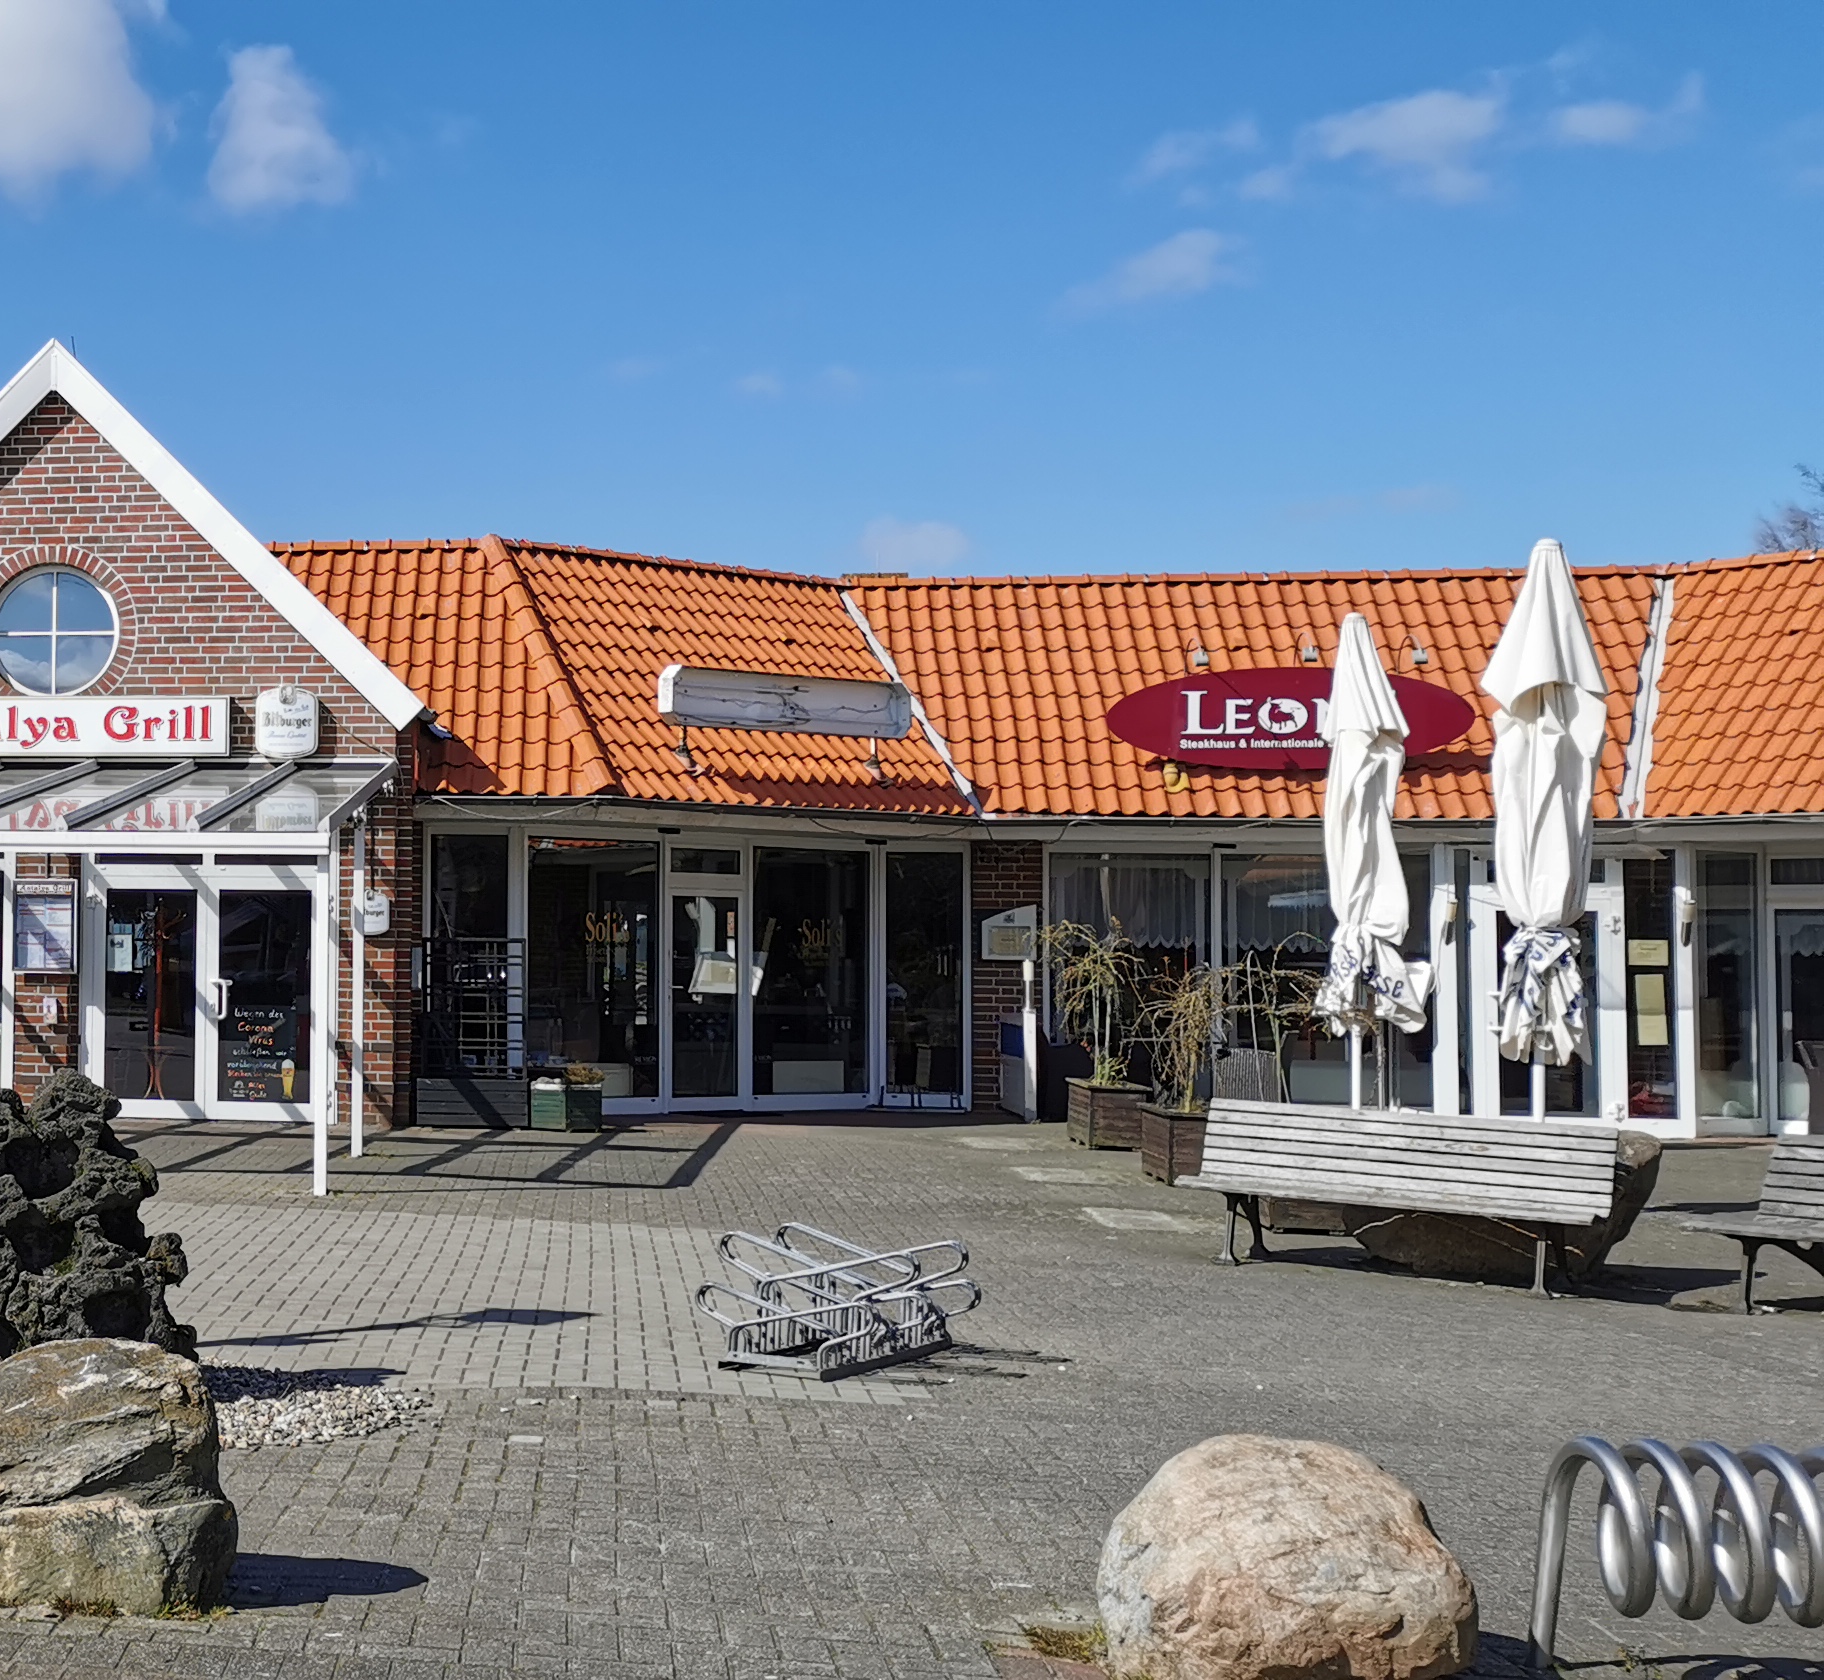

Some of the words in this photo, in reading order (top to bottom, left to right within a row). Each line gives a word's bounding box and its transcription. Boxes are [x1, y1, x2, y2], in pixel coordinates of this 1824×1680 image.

[103, 704, 213, 743] Grill
[1179, 738, 1236, 749] Steakhaus
[1238, 738, 1247, 749] &
[1250, 737, 1324, 749] Internationale
[234, 1006, 265, 1021] Wegen
[237, 1020, 274, 1033] Corona
[248, 1033, 274, 1046] Virus
